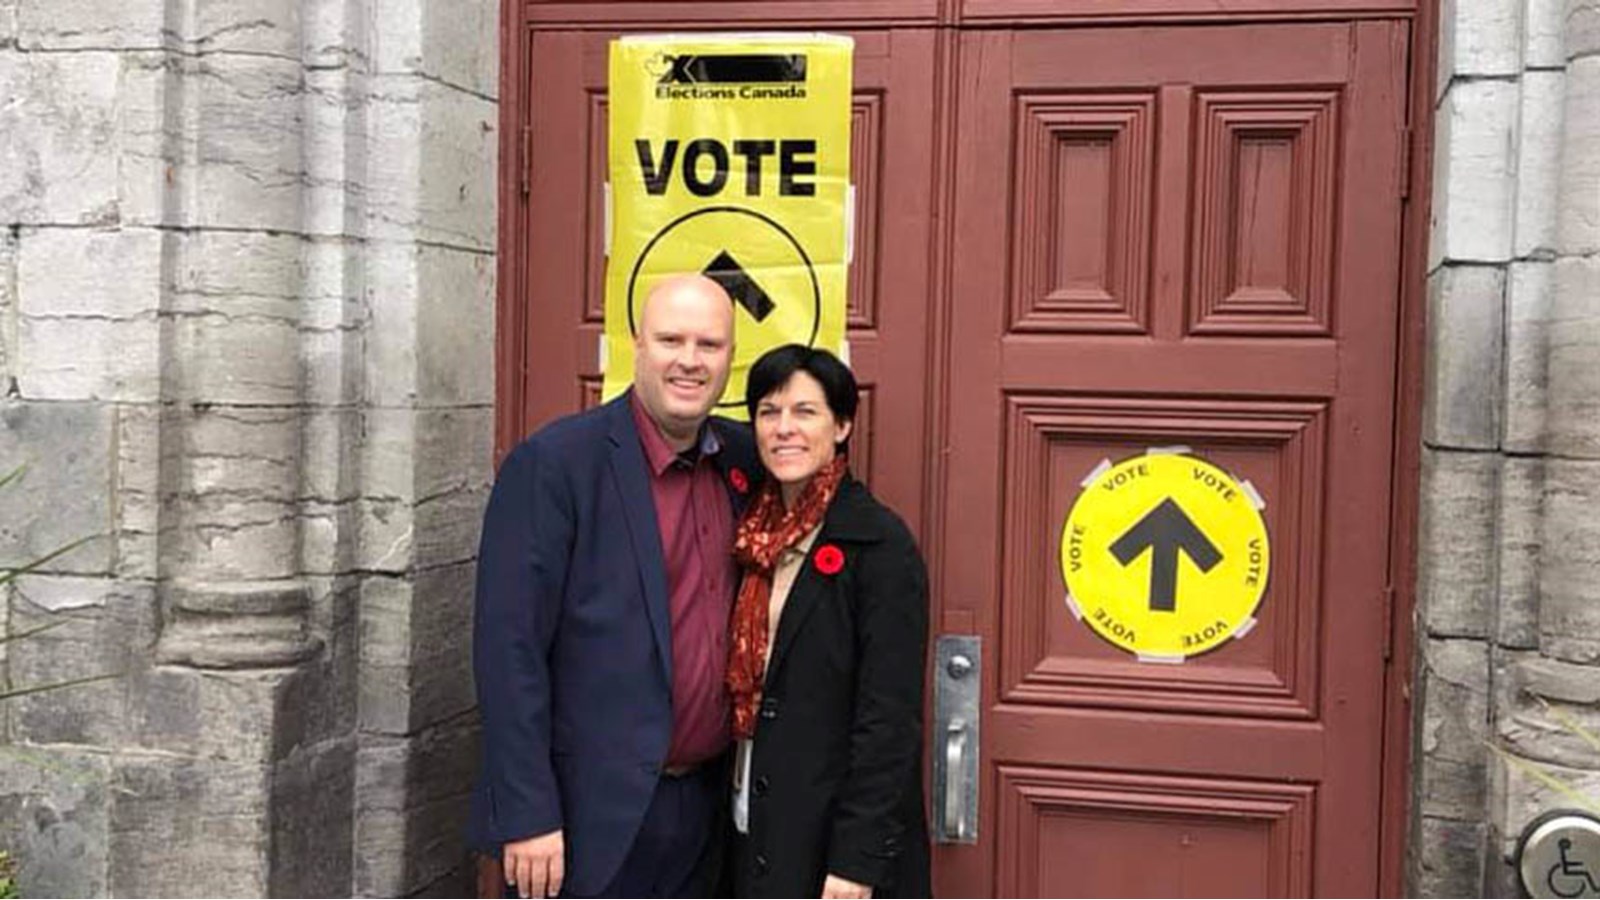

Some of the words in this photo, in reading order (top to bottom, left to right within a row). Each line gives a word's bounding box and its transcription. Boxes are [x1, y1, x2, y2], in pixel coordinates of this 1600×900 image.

[655, 86, 736, 99] Elections
[739, 85, 807, 99] Canada
[634, 138, 816, 197] VOTE
[1102, 464, 1149, 492] VOTE
[1192, 468, 1237, 503] VOTE
[1069, 523, 1086, 572] VOTE
[1245, 538, 1262, 587] VOTE
[1094, 607, 1136, 643] VOTE
[1181, 620, 1229, 648] VOTE
